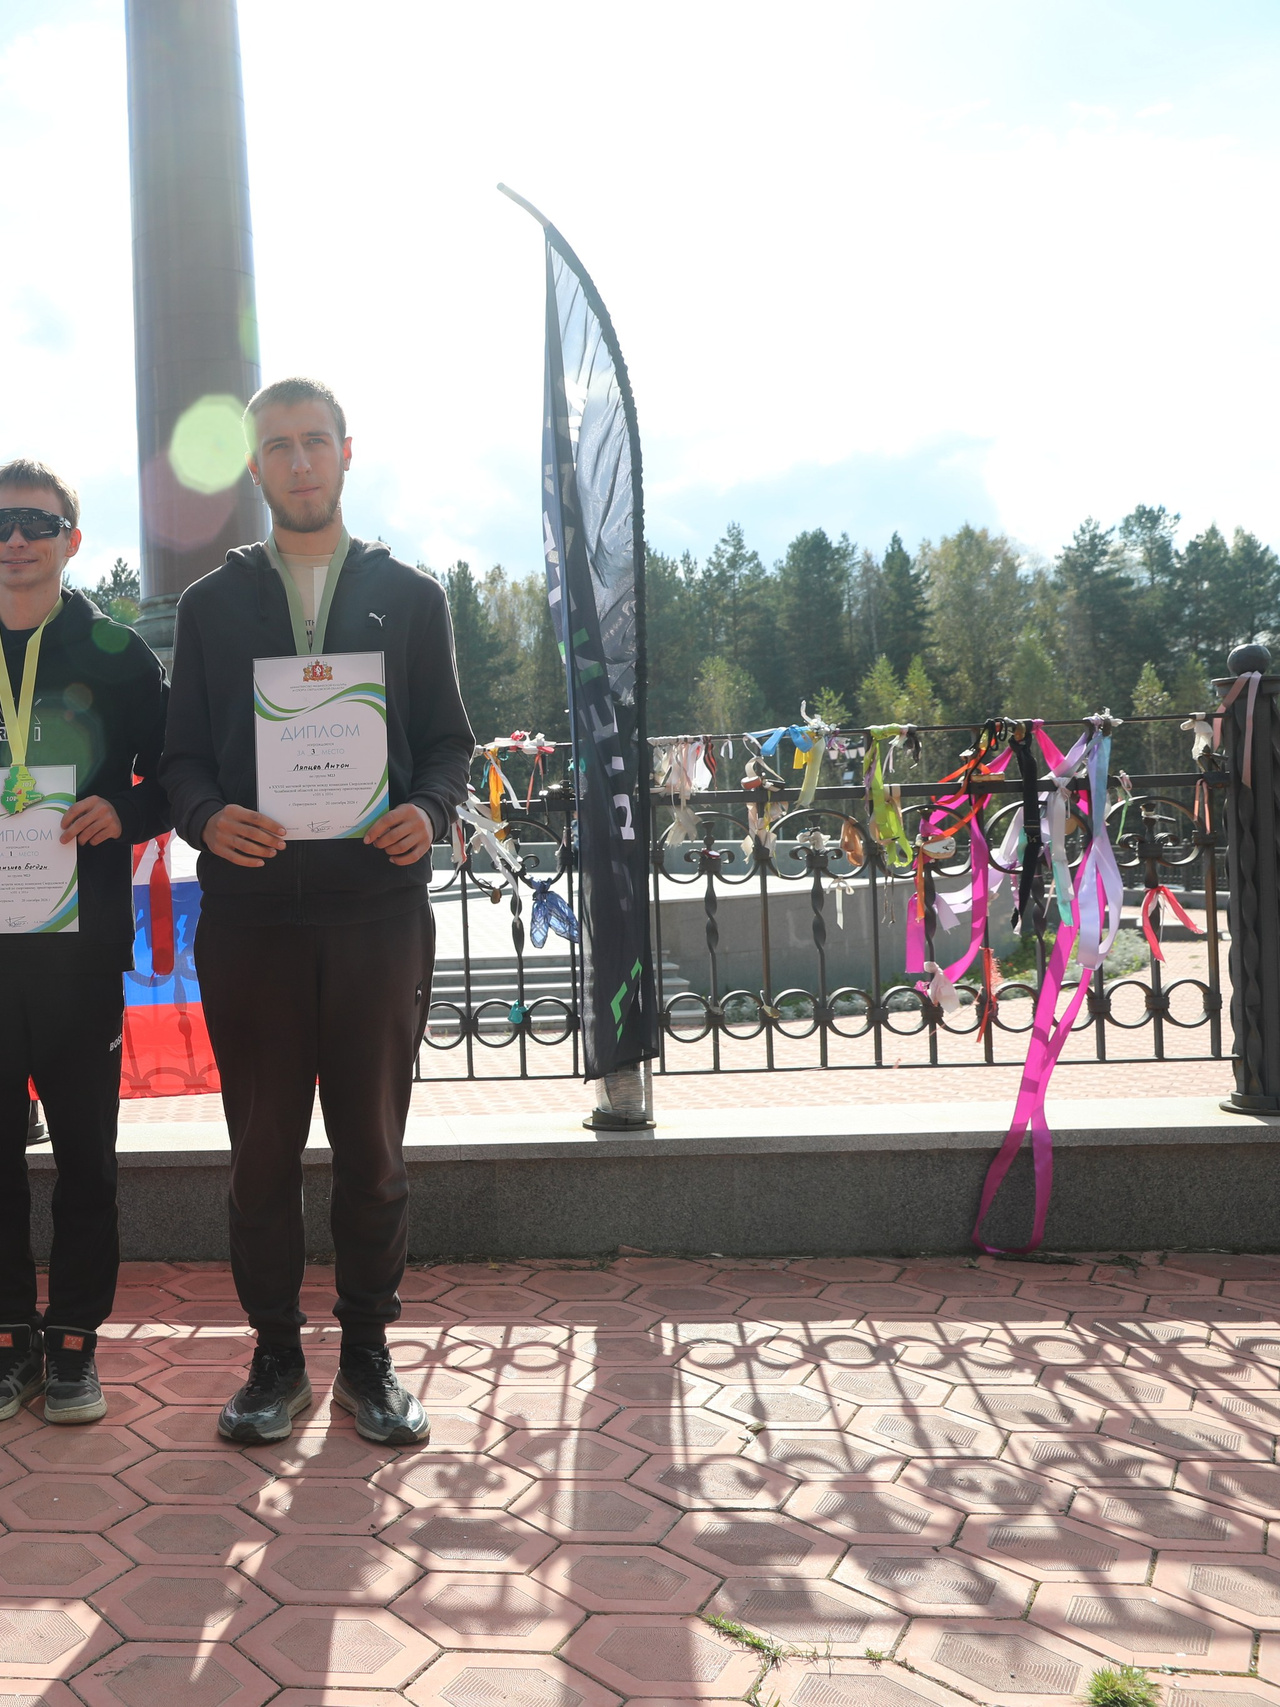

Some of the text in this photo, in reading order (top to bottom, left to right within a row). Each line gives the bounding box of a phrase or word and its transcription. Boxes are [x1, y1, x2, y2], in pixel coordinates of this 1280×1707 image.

[280, 723, 360, 741] ДИПЛОМ
[321, 748, 345, 756] МЕСТО
[324, 762, 350, 770] Антон
[18, 850, 40, 858] МЕСТО
